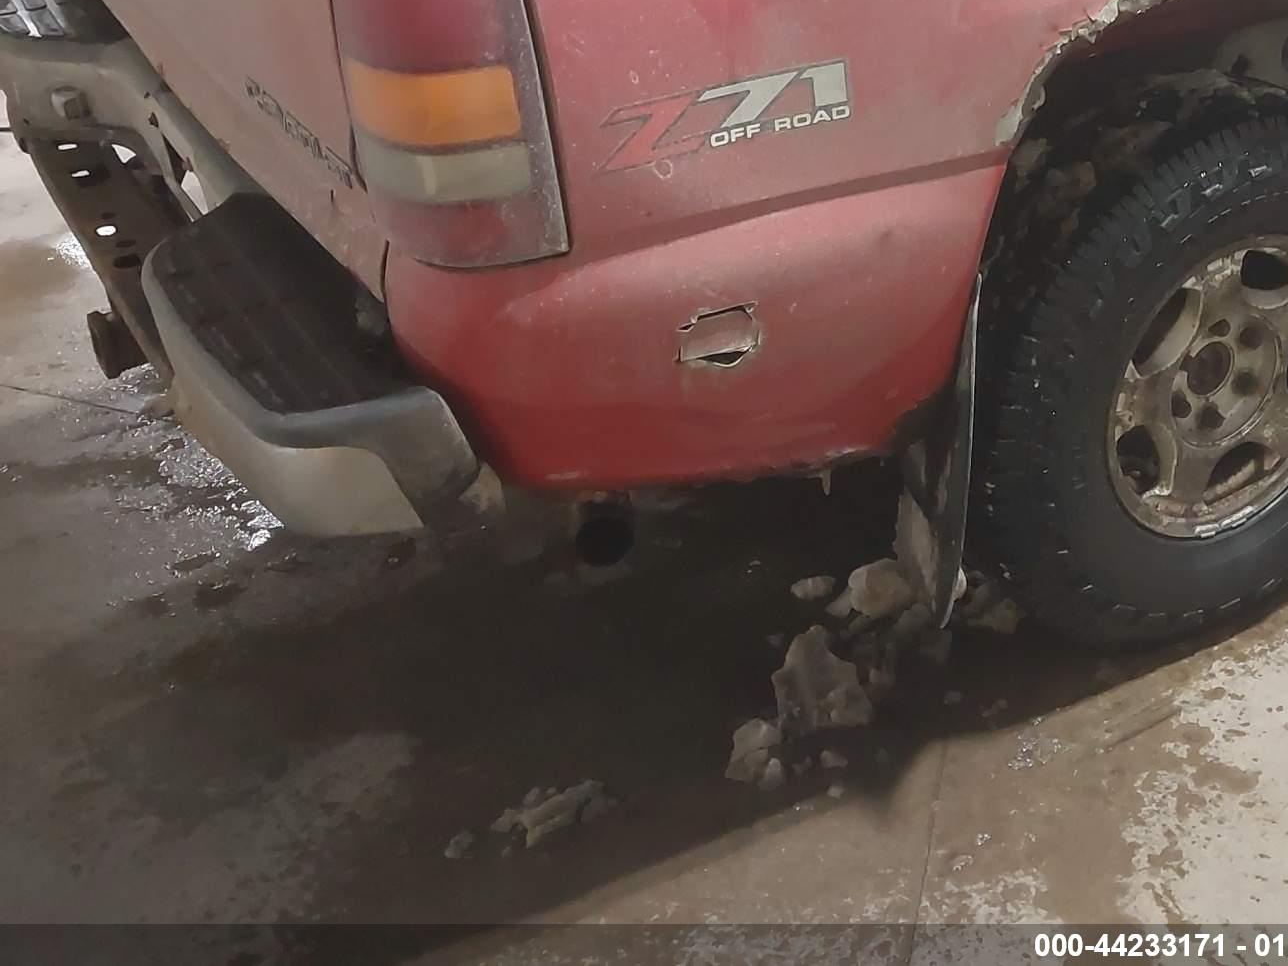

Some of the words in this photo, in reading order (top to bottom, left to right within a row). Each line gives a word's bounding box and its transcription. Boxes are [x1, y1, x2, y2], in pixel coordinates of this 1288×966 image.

[600, 60, 849, 172] Z71
[710, 123, 761, 148] OFF
[774, 105, 851, 132] ROAD
